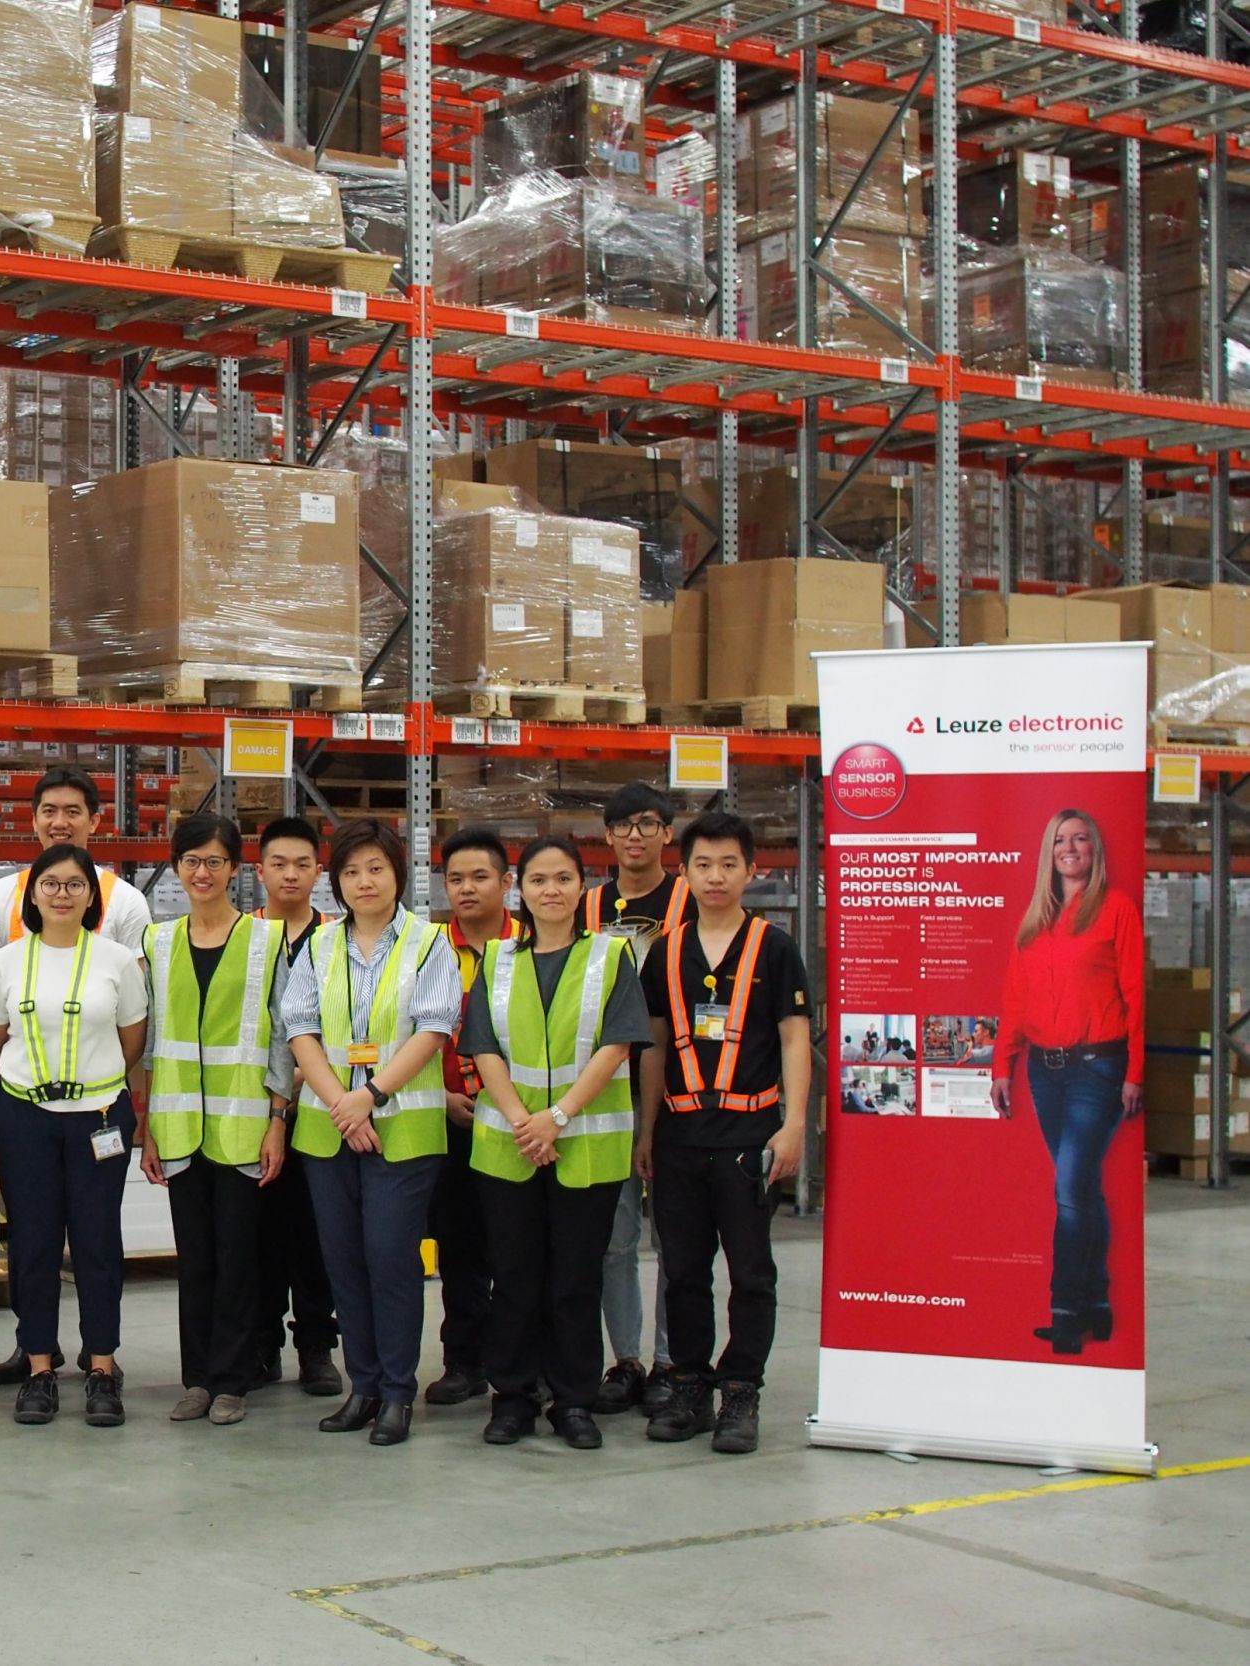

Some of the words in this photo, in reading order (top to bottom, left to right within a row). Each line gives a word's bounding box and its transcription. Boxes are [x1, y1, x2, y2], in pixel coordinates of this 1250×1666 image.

[936, 716, 1002, 734] Leuze
[1008, 713, 1124, 732] electronic
[338, 727, 357, 735] G01-12
[237, 745, 279, 756] DAMAGE
[1009, 741, 1029, 752] the
[1033, 742, 1076, 752] sensor
[1080, 741, 1124, 752] people
[845, 758, 888, 769] SMART
[838, 772, 895, 783] SENSOR
[838, 787, 896, 798] BUSINESS
[840, 852, 869, 864] OUR
[873, 852, 920, 863] MOST
[925, 851, 1021, 863] IMPORTANT
[840, 866, 917, 878] PRODUCT
[922, 867, 934, 877] IS
[840, 881, 963, 892] PROFESSIONAL
[840, 896, 930, 907] CUSTOMER
[934, 896, 1005, 907] SERVICE
[839, 1290, 966, 1307] www.leuze.com
